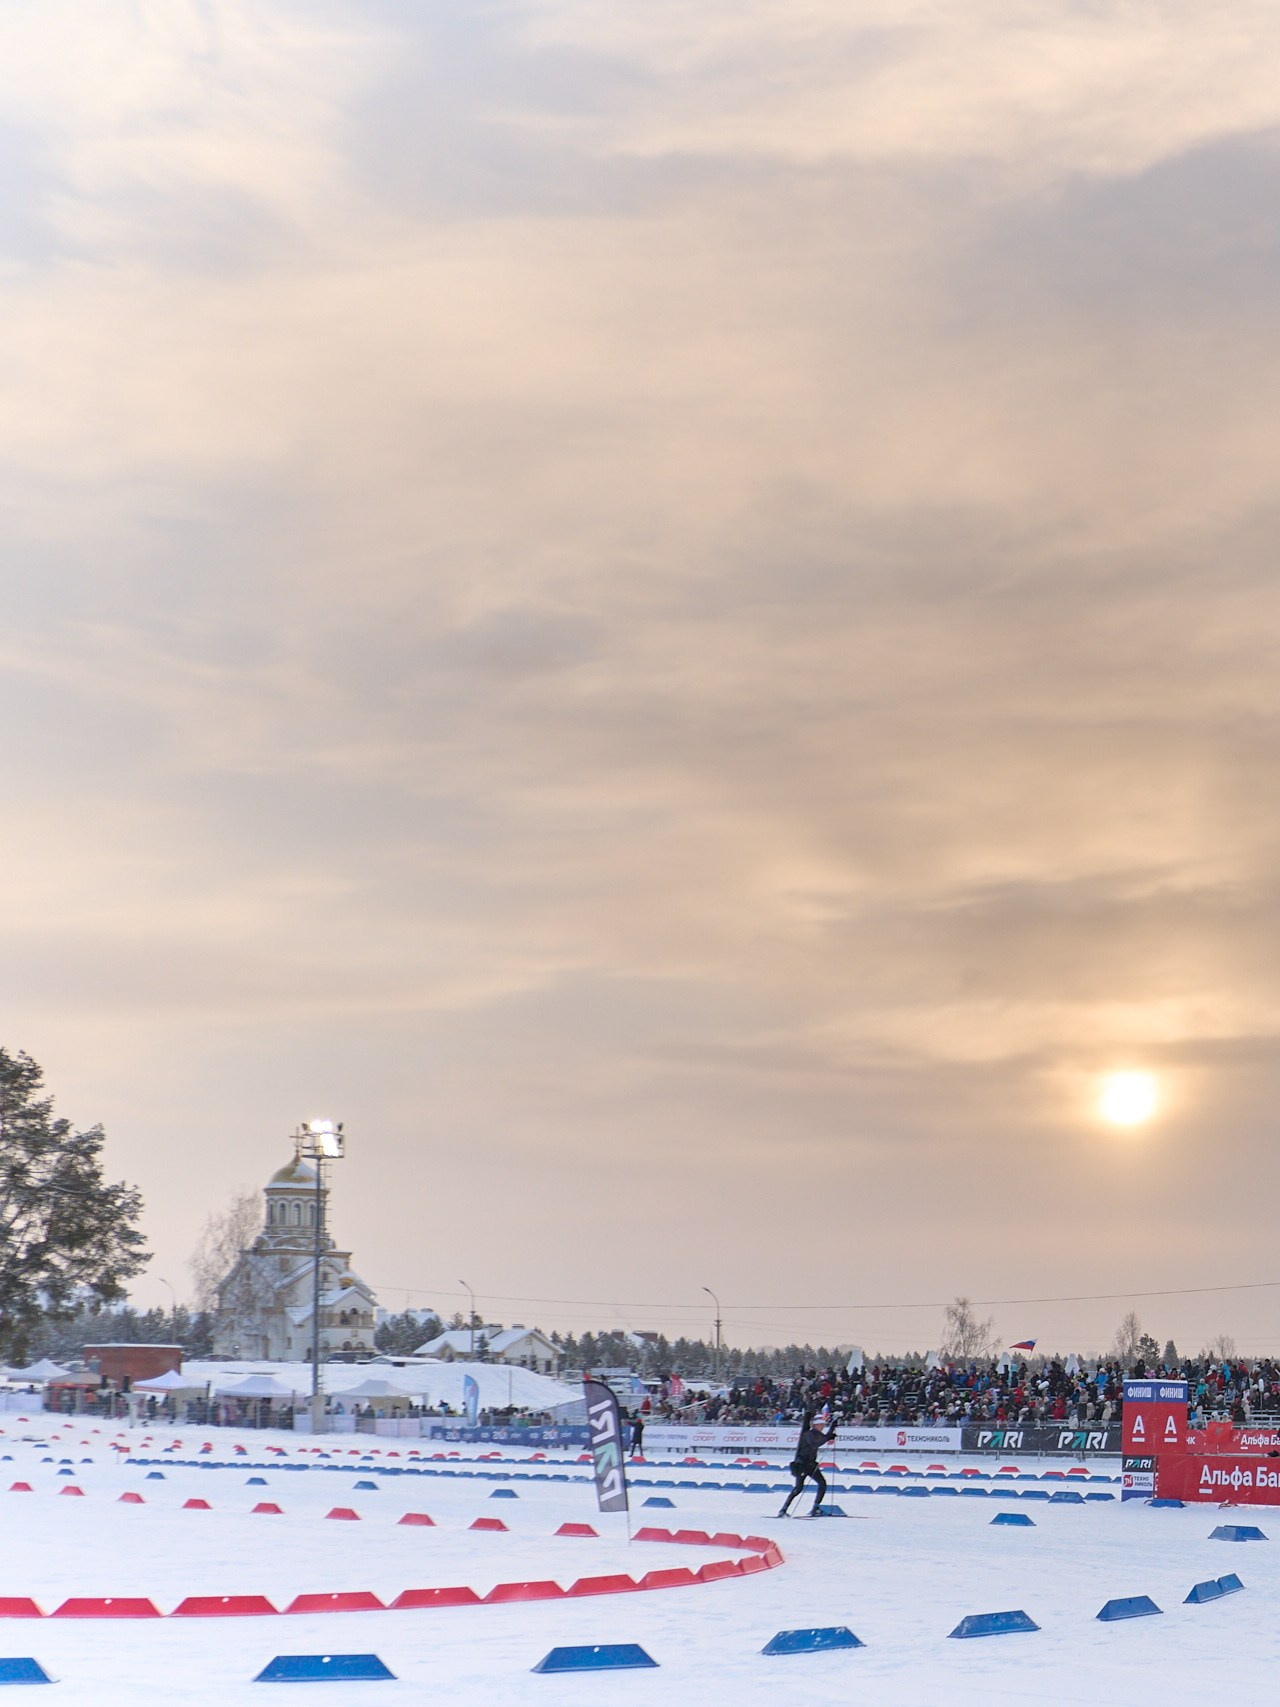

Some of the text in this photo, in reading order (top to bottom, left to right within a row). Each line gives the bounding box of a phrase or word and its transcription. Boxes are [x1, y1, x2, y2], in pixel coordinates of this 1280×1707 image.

[1127, 1386, 1151, 1398] ФИНИШ
[1159, 1386, 1184, 1399] ФИНИШ
[907, 1435, 950, 1443] ТЕХНОНИКОЛЬ
[977, 1431, 1023, 1448] PARI
[1057, 1431, 1108, 1449] PARI
[1240, 1433, 1269, 1448] Альфа
[1124, 1459, 1152, 1469] PARI
[1200, 1464, 1253, 1490] Альфа
